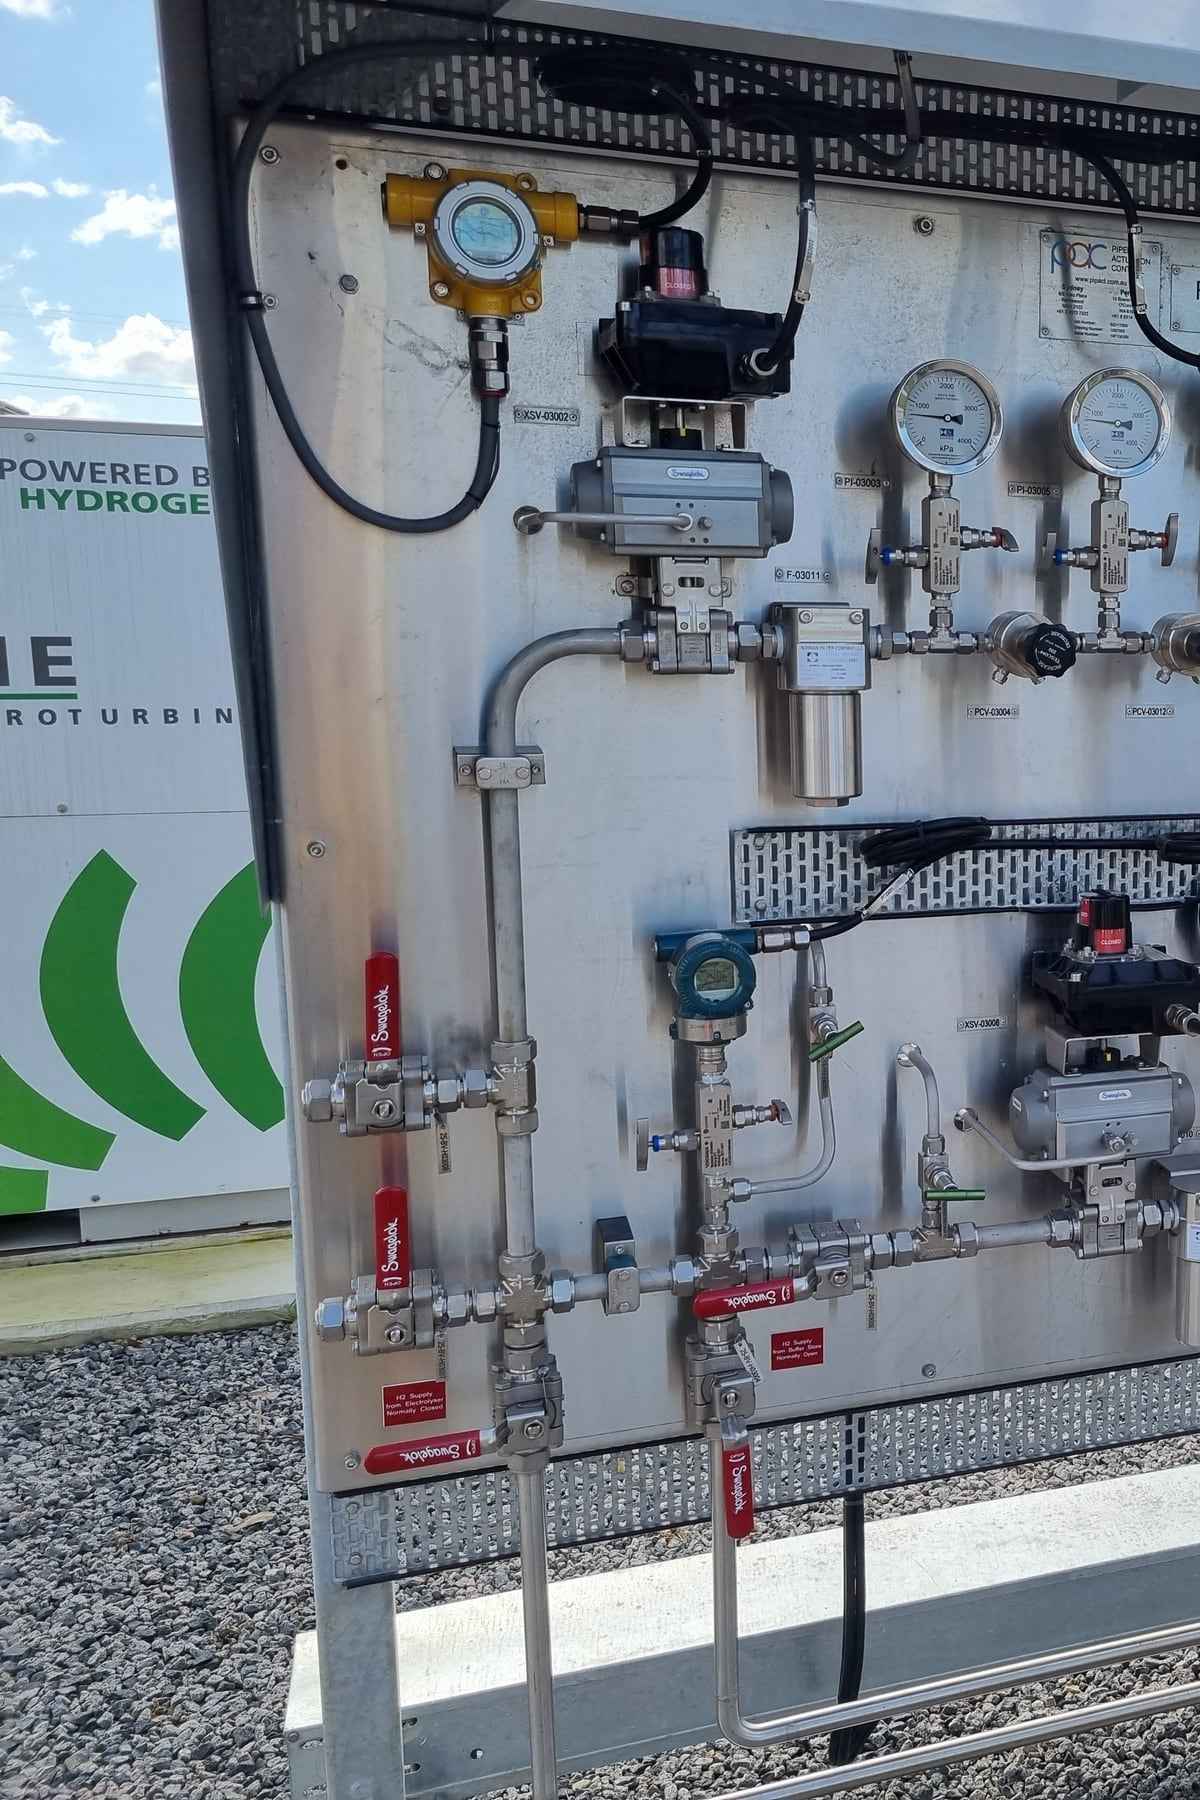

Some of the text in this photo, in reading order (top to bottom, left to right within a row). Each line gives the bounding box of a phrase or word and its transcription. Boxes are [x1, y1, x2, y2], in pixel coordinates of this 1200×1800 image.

[522, 409, 570, 423] XSV-03002
[0, 457, 167, 487] POWERED
[786, 570, 820, 581] F-03011
[371, 985, 391, 1042] Swagelok
[381, 1217, 399, 1272] Swagelok
[727, 1289, 777, 1309] Swagelok
[409, 1391, 433, 1400] Supply
[386, 1404, 444, 1417] Normally Closed
[399, 1444, 461, 1464] Swagelok
[731, 1465, 747, 1514] Swagelok
